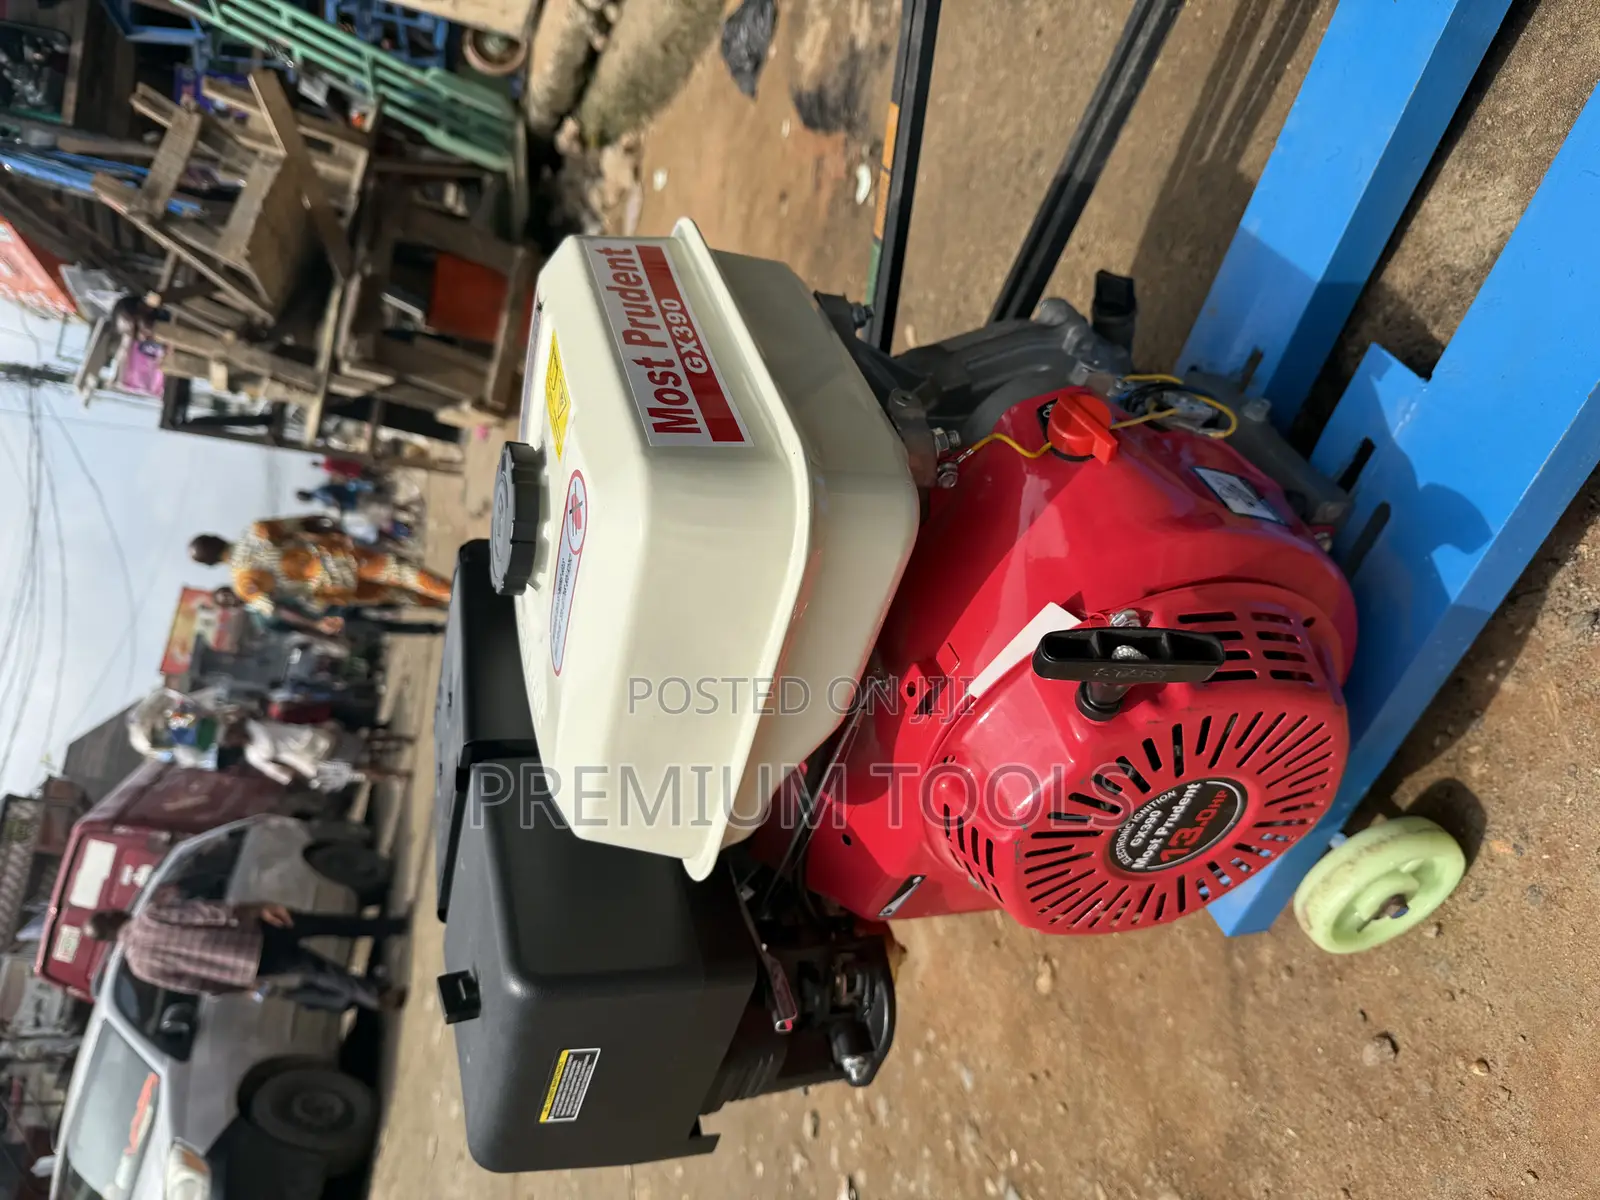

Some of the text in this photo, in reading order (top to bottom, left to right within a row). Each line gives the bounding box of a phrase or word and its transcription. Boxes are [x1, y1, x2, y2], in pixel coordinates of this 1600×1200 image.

[594, 247, 702, 434] Most Prudent
[660, 298, 709, 374] GX390
[1130, 809, 1163, 847] GX390
[1131, 783, 1202, 869] Most Prudent
[1132, 790, 1178, 822] IGNITION
